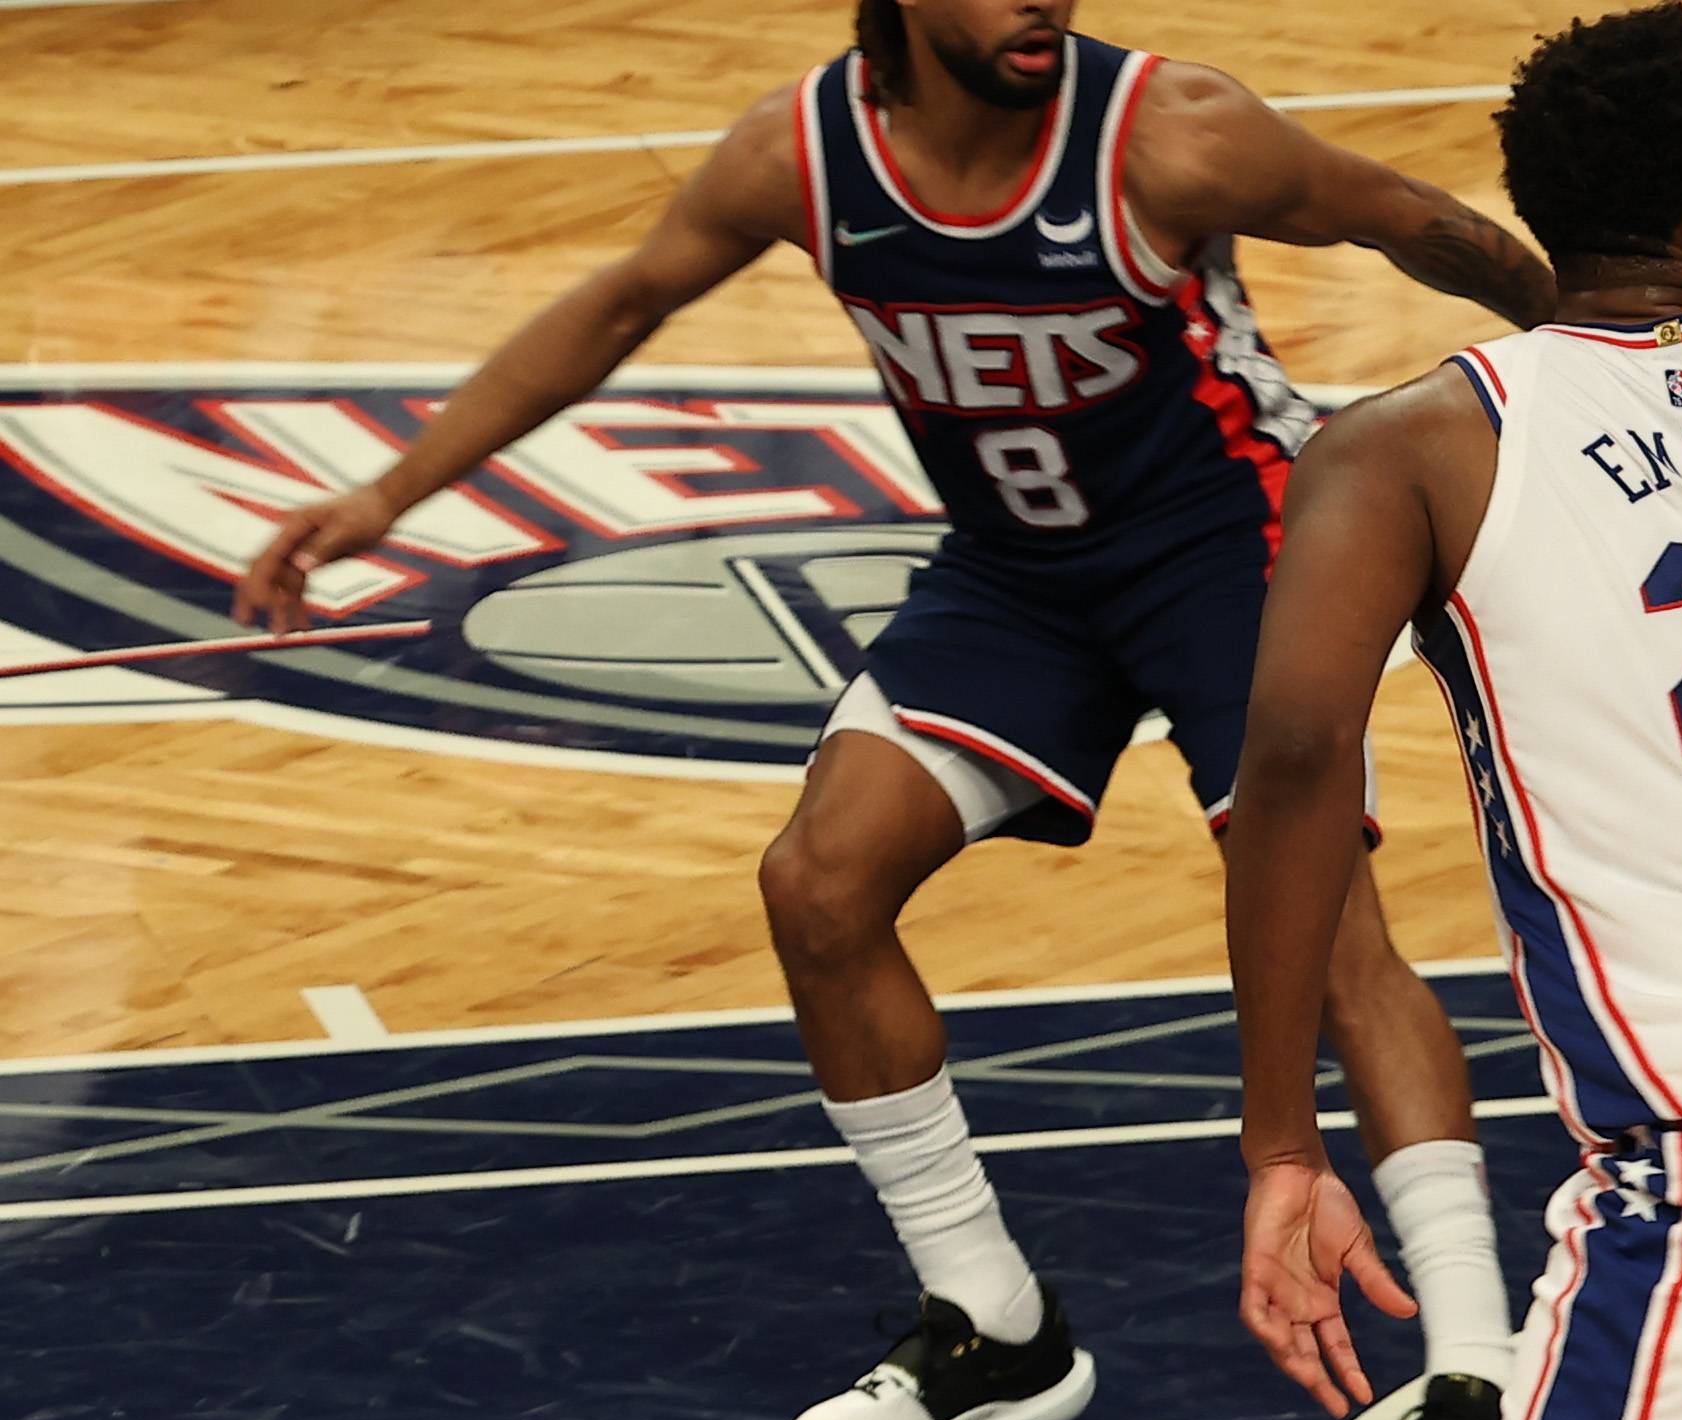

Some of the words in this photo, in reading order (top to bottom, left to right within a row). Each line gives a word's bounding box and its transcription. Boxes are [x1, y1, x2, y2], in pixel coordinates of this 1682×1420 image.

[846, 302, 1147, 412] NETS
[0, 398, 947, 618] NET
[974, 424, 1091, 529] 8
